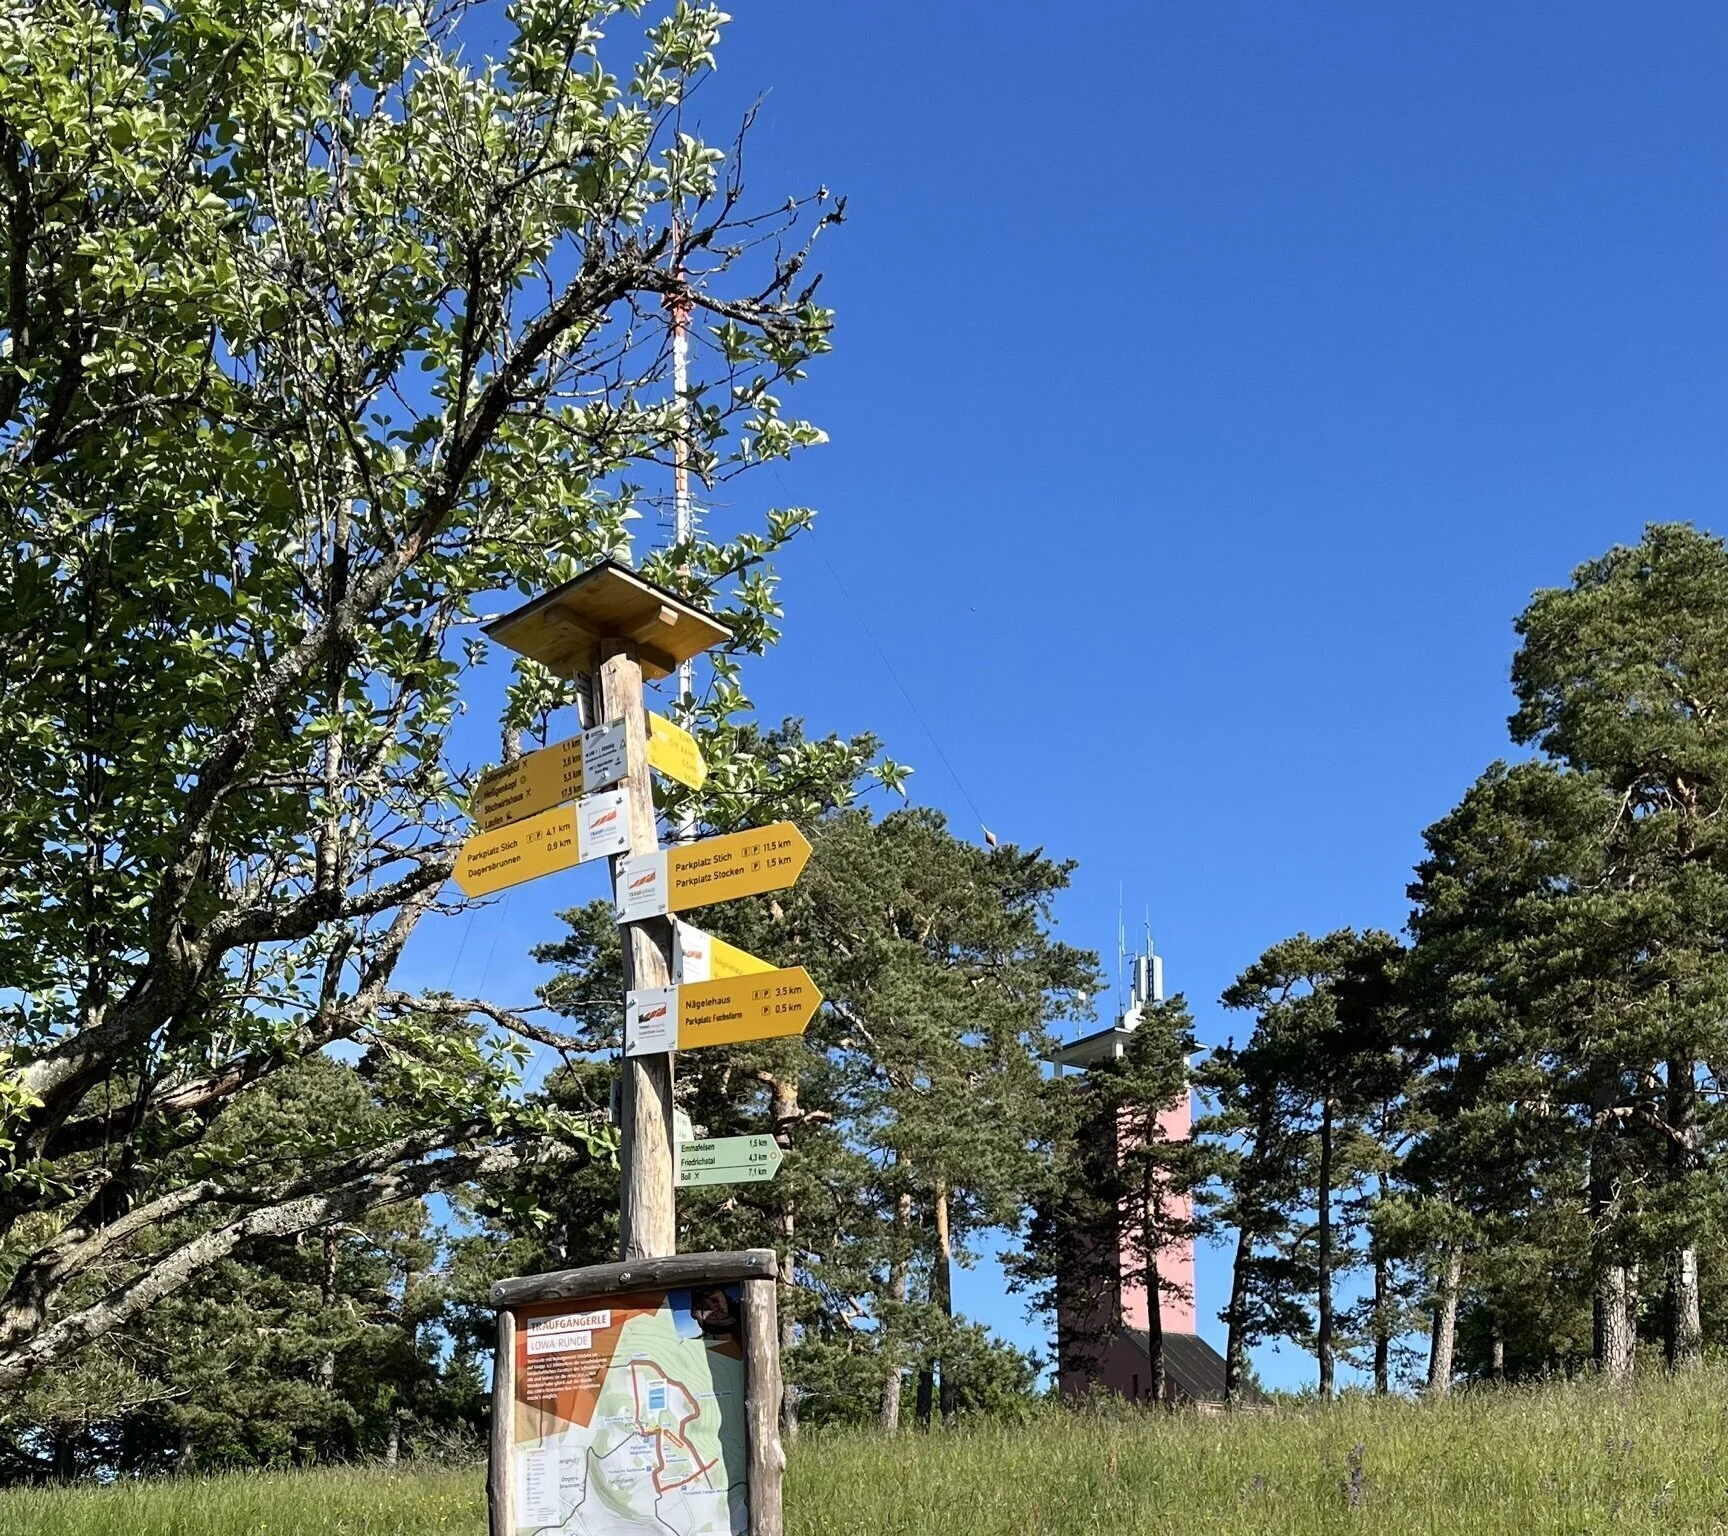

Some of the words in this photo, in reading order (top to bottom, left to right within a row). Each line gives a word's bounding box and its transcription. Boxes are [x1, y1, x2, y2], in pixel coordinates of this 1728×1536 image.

[572, 740, 580, 748] km
[572, 755, 581, 763] km
[573, 770, 581, 778] km
[485, 816, 503, 829] Laufen
[574, 785, 582, 793] km
[468, 846, 499, 862] Parkplatz
[500, 840, 518, 851] Stich
[559, 824, 570, 832] km
[468, 855, 521, 878] Dagersbrunnen
[560, 839, 571, 847] km
[676, 858, 711, 872] Parkplatz
[713, 853, 732, 863] Stich
[778, 840, 791, 848] km
[676, 874, 712, 888] Parkplatz
[714, 867, 745, 880] Stocken
[778, 857, 791, 865] km
[686, 997, 731, 1010] Nägelehaus
[789, 986, 802, 994] km
[686, 1016, 711, 1026] Parkplatz
[681, 1144, 715, 1152] Emmafelsen
[681, 1157, 715, 1166] Friedrichstal
[531, 1336, 588, 1351] LOWA-RUNDE
